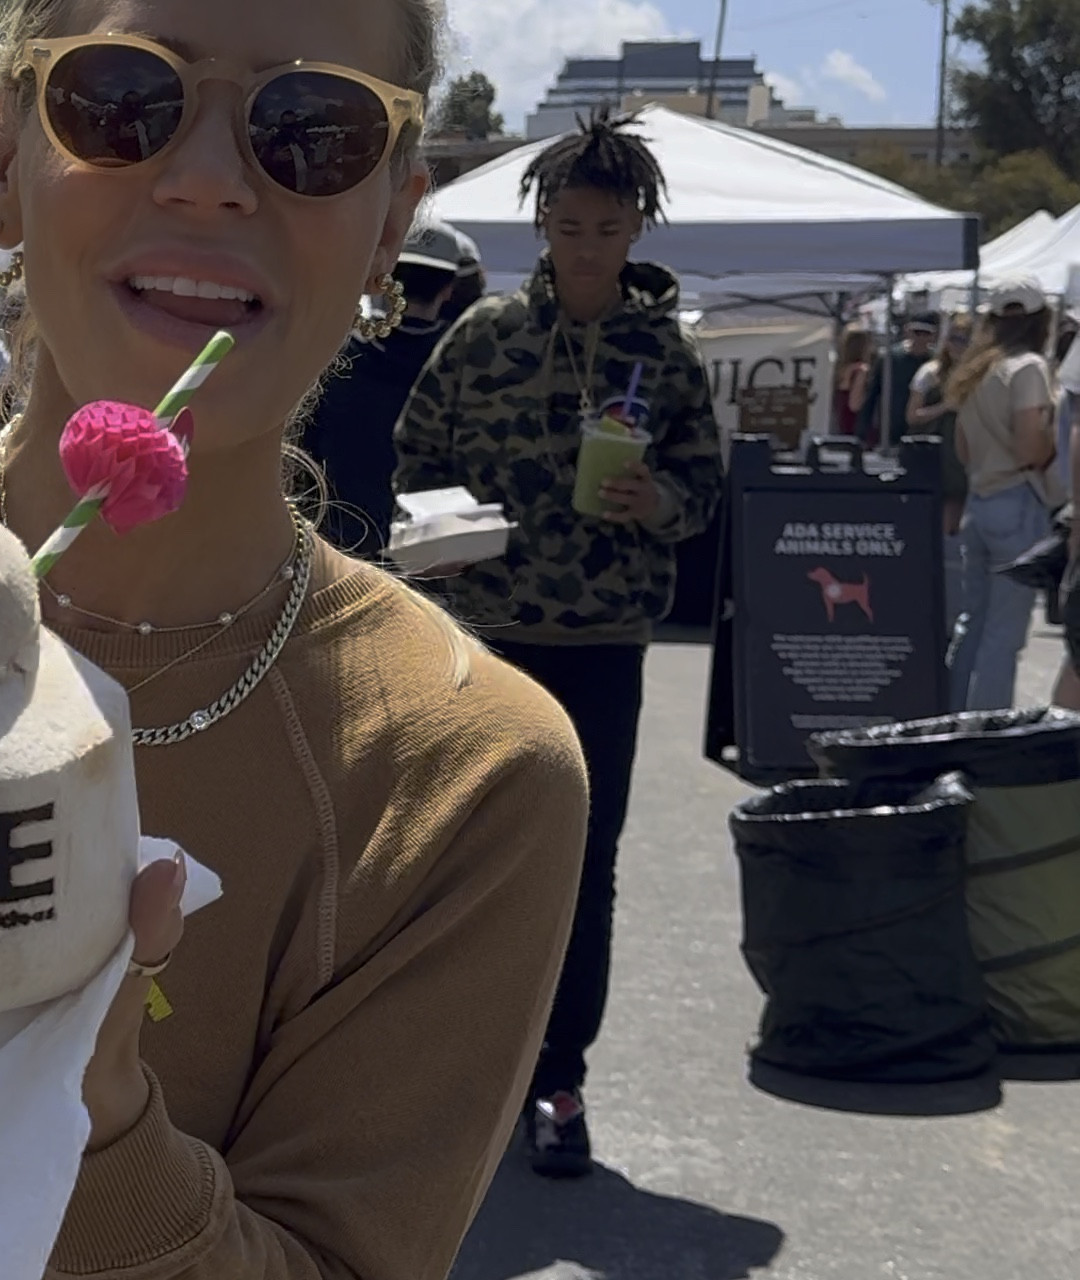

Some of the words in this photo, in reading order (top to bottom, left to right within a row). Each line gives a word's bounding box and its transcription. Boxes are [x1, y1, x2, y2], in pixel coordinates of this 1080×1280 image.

[782, 522, 819, 539] ADA
[822, 523, 895, 540] SERVICE
[774, 538, 853, 555] ANIMALS
[855, 539, 906, 556] ONLY
